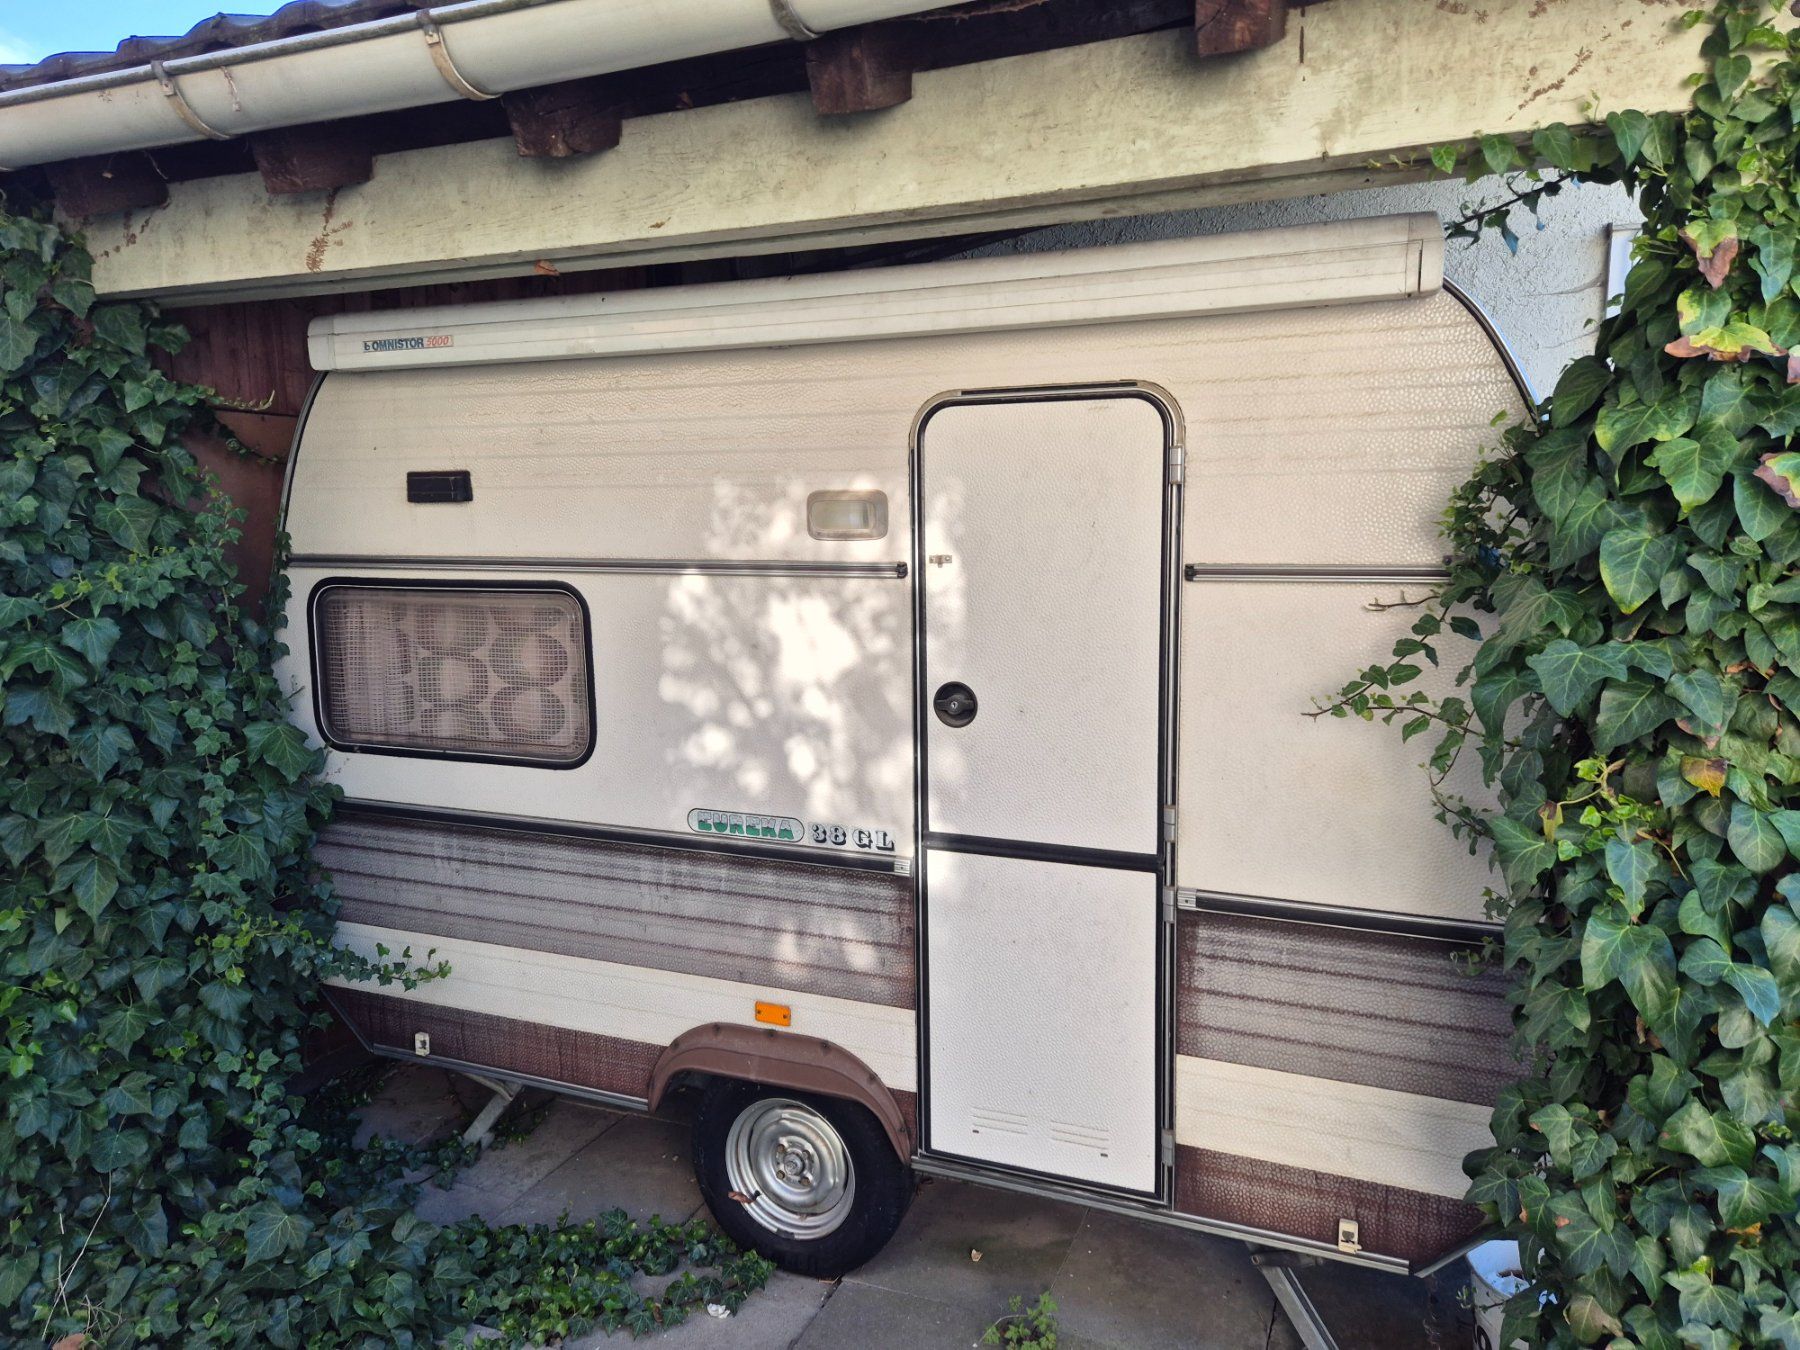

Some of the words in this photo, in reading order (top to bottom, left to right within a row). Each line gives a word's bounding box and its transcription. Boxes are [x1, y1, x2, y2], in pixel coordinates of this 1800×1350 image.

[371, 336, 424, 351] OMNISTOR
[697, 811, 795, 840] EUREKA
[811, 823, 847, 846] 38
[852, 828, 895, 851] GL
